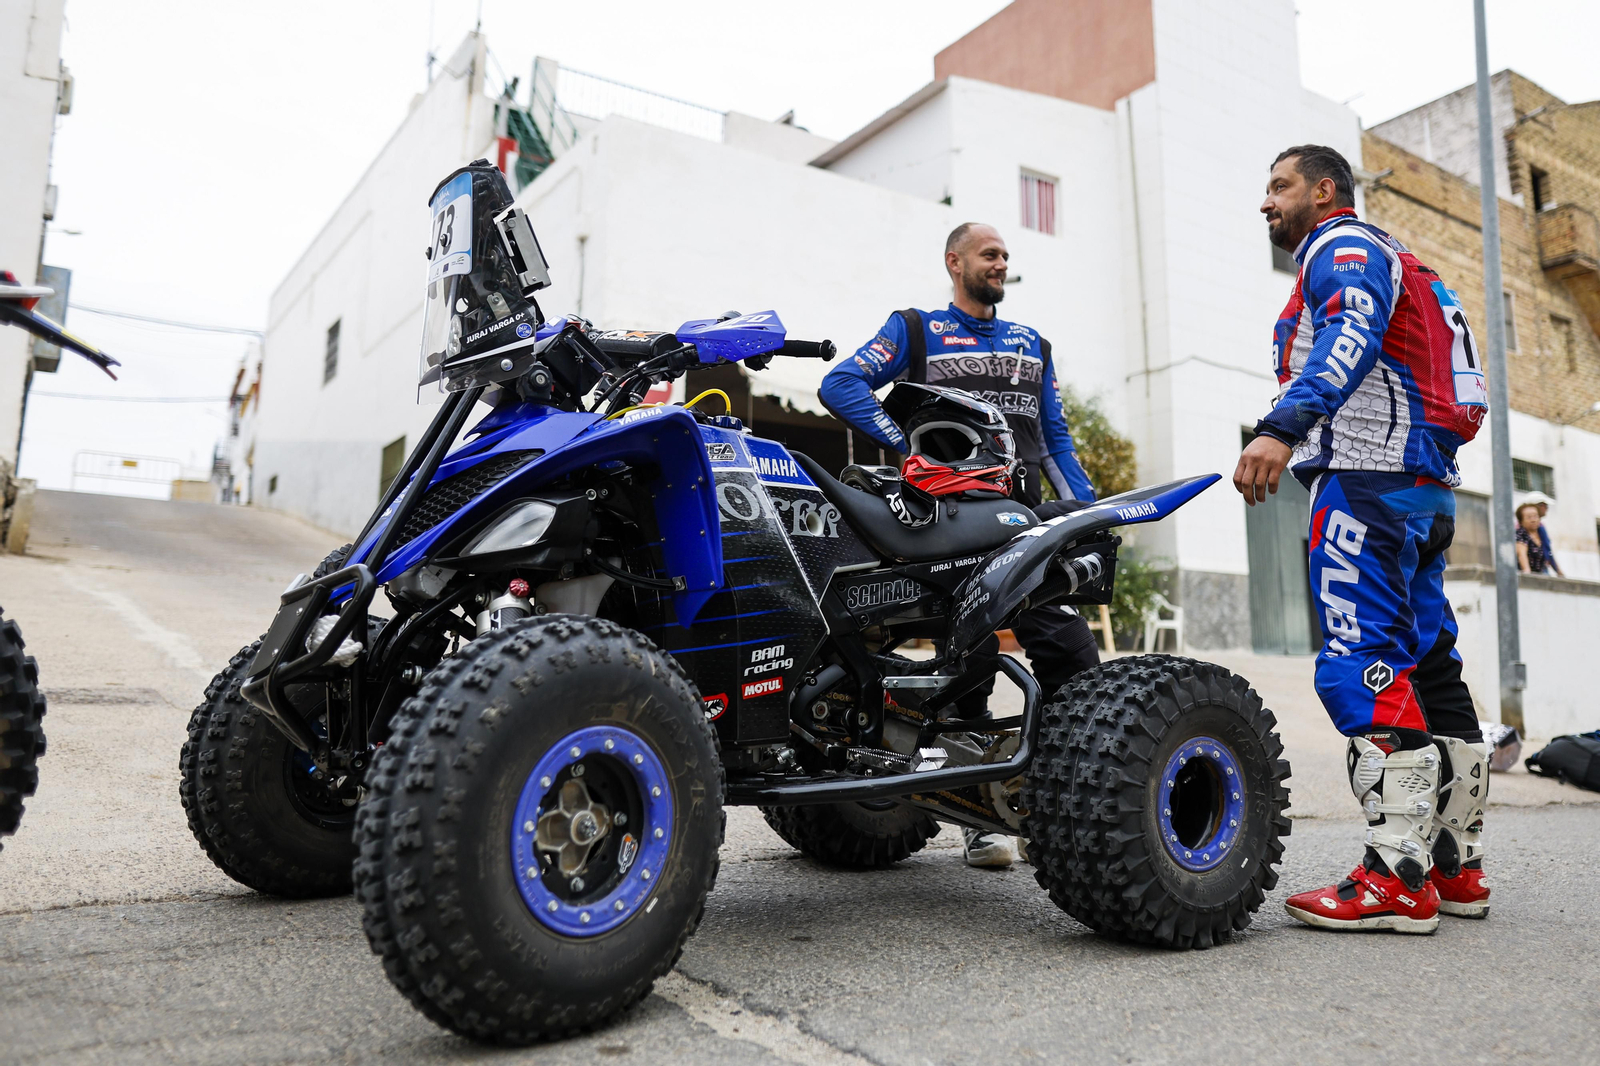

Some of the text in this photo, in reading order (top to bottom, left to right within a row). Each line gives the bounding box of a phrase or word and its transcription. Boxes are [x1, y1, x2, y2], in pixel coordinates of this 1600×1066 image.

[1333, 262, 1366, 274] POLAND
[466, 328, 488, 344] JURAJ
[489, 317, 515, 333] VARGA
[944, 337, 977, 345] MOTUL
[618, 407, 663, 426] YAMAHA
[750, 455, 799, 478] AMAHA
[1115, 502, 1158, 520] YAMAHA
[930, 562, 952, 573] JURAJ
[954, 557, 977, 568] VARGA
[882, 579, 921, 604] RACE
[744, 657, 794, 677] racing
[744, 679, 781, 697] MOTUL
